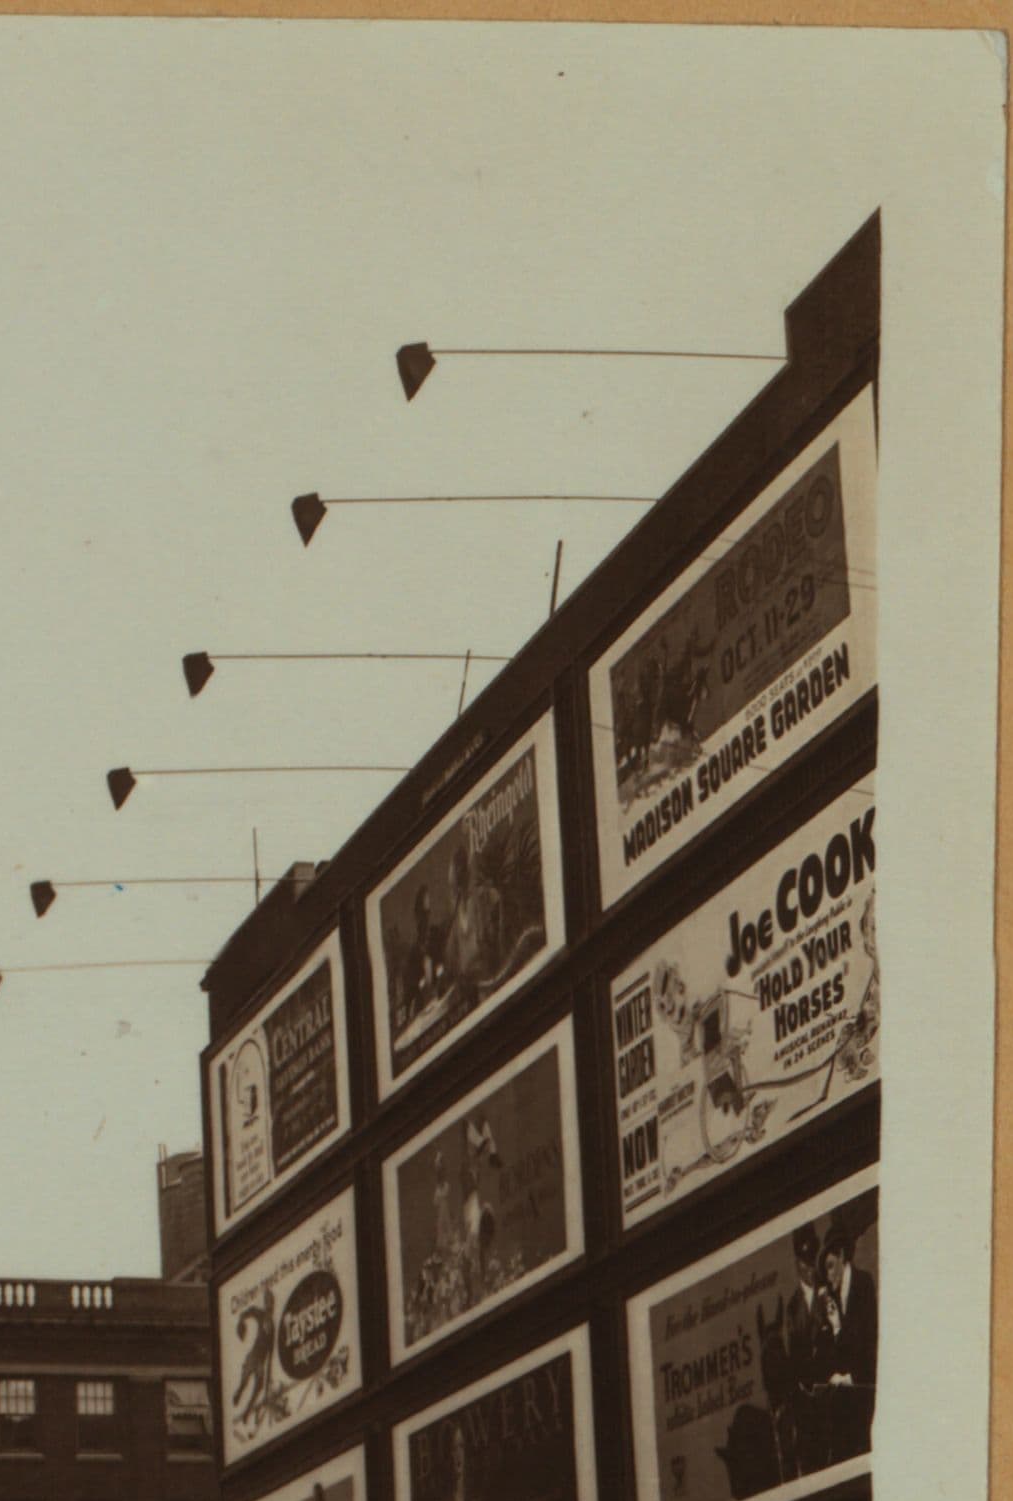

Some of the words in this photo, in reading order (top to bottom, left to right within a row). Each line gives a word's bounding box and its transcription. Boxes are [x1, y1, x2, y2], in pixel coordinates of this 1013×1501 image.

[715, 475, 833, 631] RODEO
[624, 784, 693, 866] MADISON
[697, 716, 767, 814] SQUARE
[771, 641, 850, 742] GARDEN
[726, 908, 772, 979] Joe
[776, 806, 876, 934] COOK
[802, 920, 852, 979] YOUR
[660, 1327, 754, 1402] TROMMER'S
